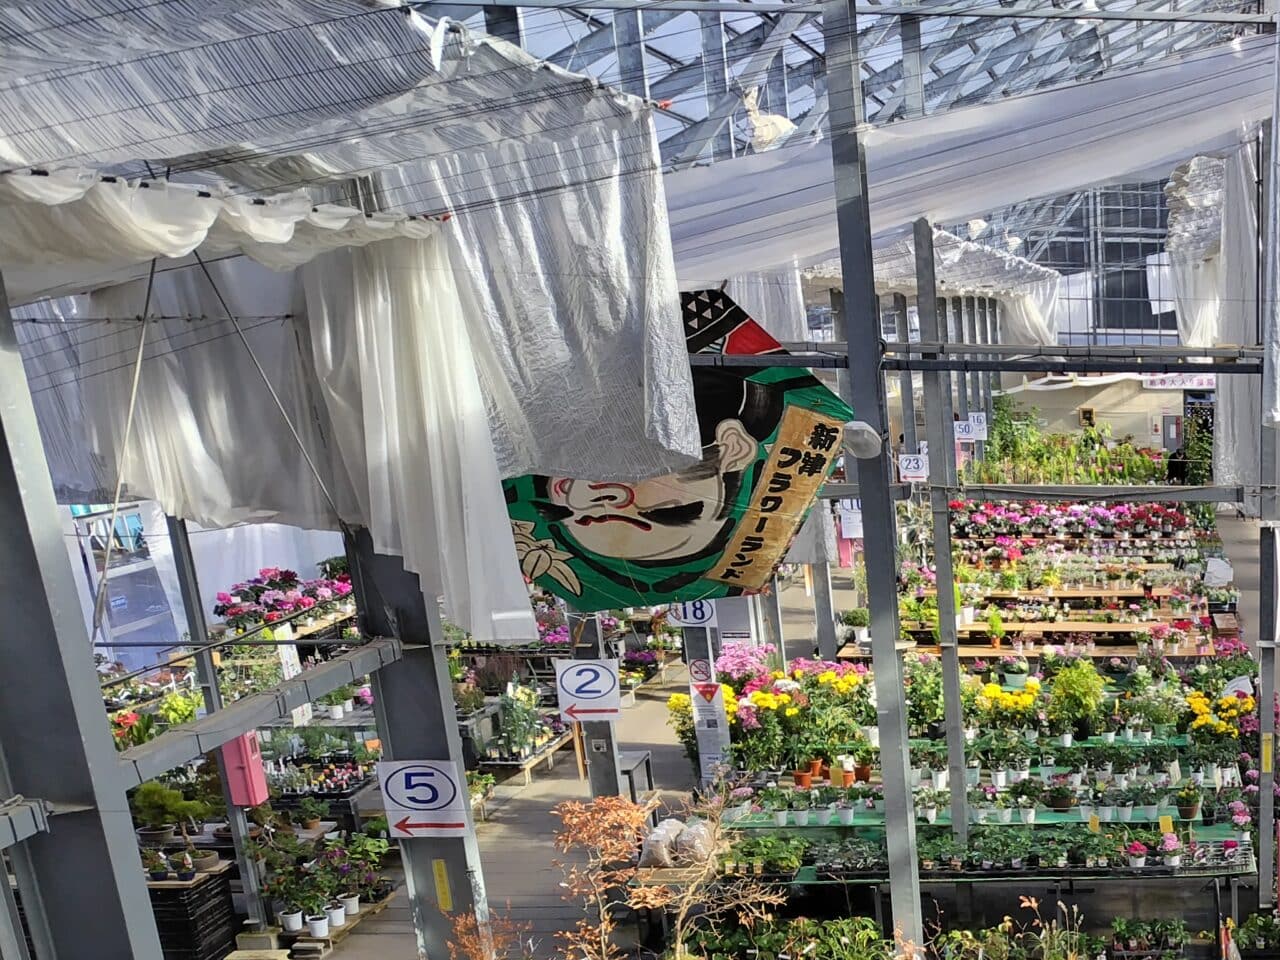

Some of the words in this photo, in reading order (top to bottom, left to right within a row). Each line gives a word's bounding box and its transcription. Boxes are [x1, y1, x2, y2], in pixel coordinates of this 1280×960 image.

[958, 424, 970, 434] 50
[800, 422, 841, 477] 新津
[904, 458, 921, 470] 23
[720, 446, 802, 580] フラワーランド
[679, 600, 706, 621] 18
[575, 668, 602, 695] 2
[403, 772, 439, 805] 5
